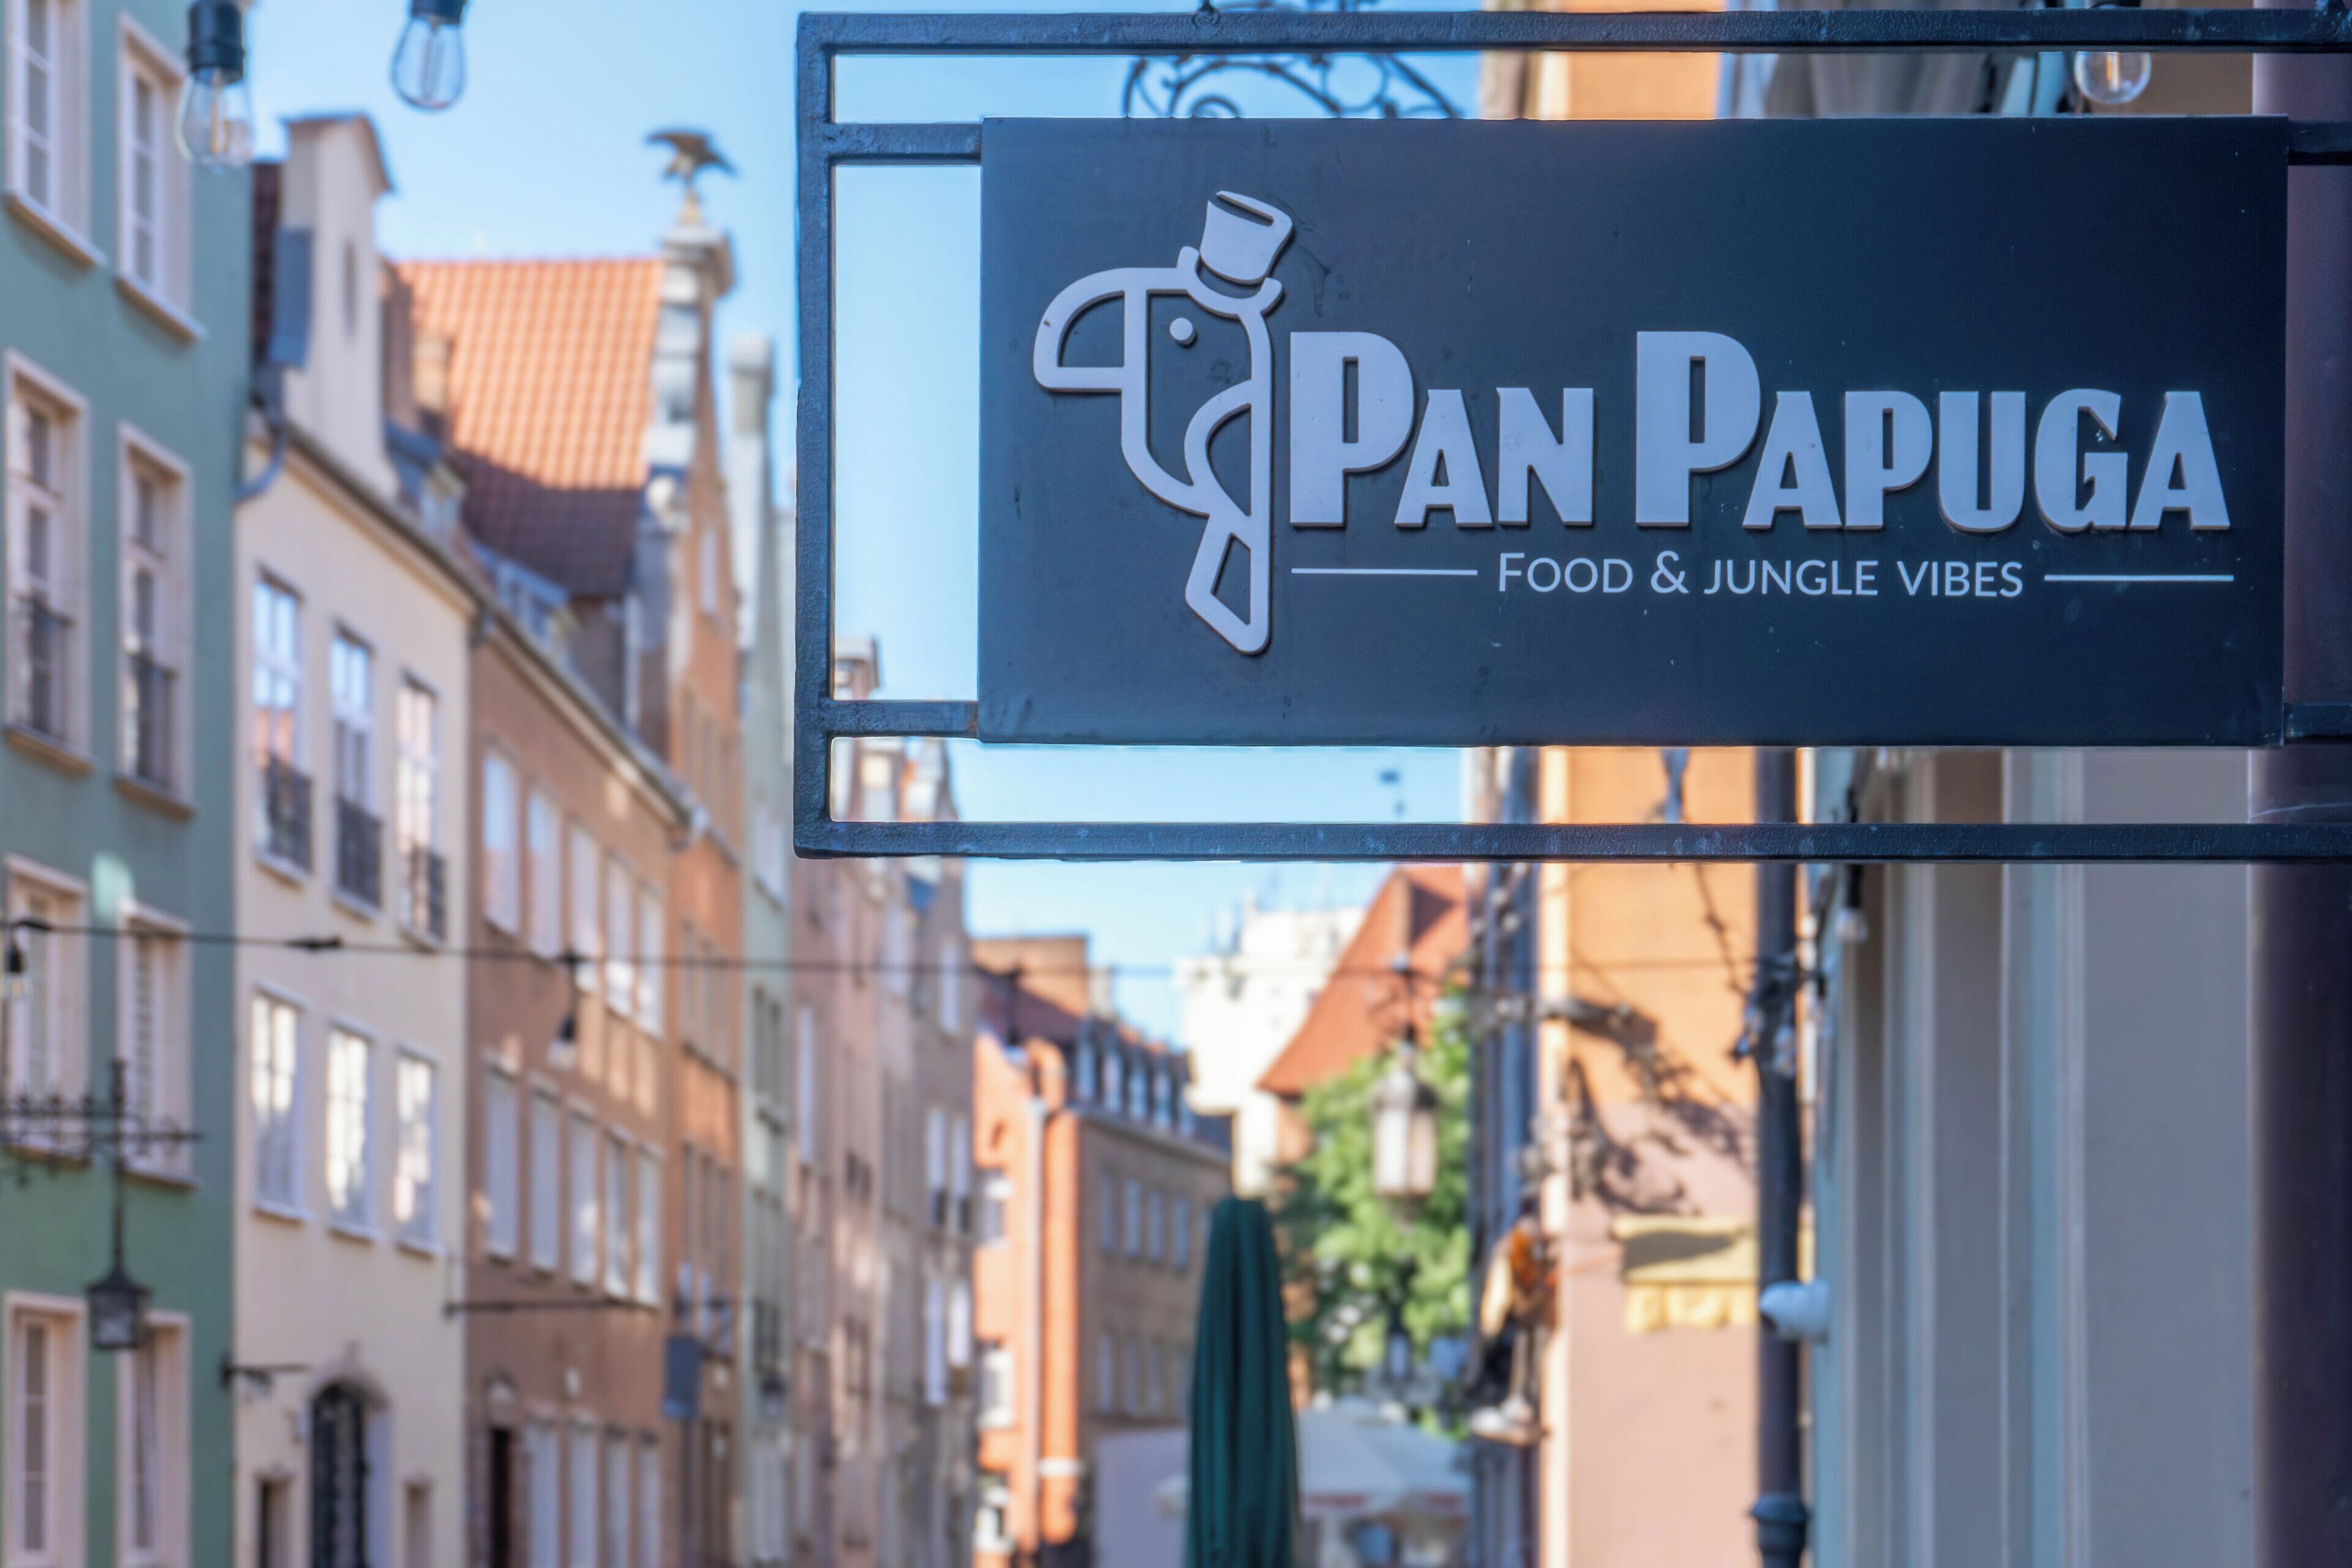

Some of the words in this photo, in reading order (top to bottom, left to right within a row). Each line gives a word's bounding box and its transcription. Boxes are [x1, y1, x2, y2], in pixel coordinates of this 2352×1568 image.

[1289, 331, 1594, 528] PAN
[1635, 330, 2231, 532] PAPUGA
[1498, 552, 1634, 594] FOOD
[1649, 550, 1690, 594] &
[1703, 559, 1879, 596] JUNGLE
[1896, 560, 2024, 598] VIBES
